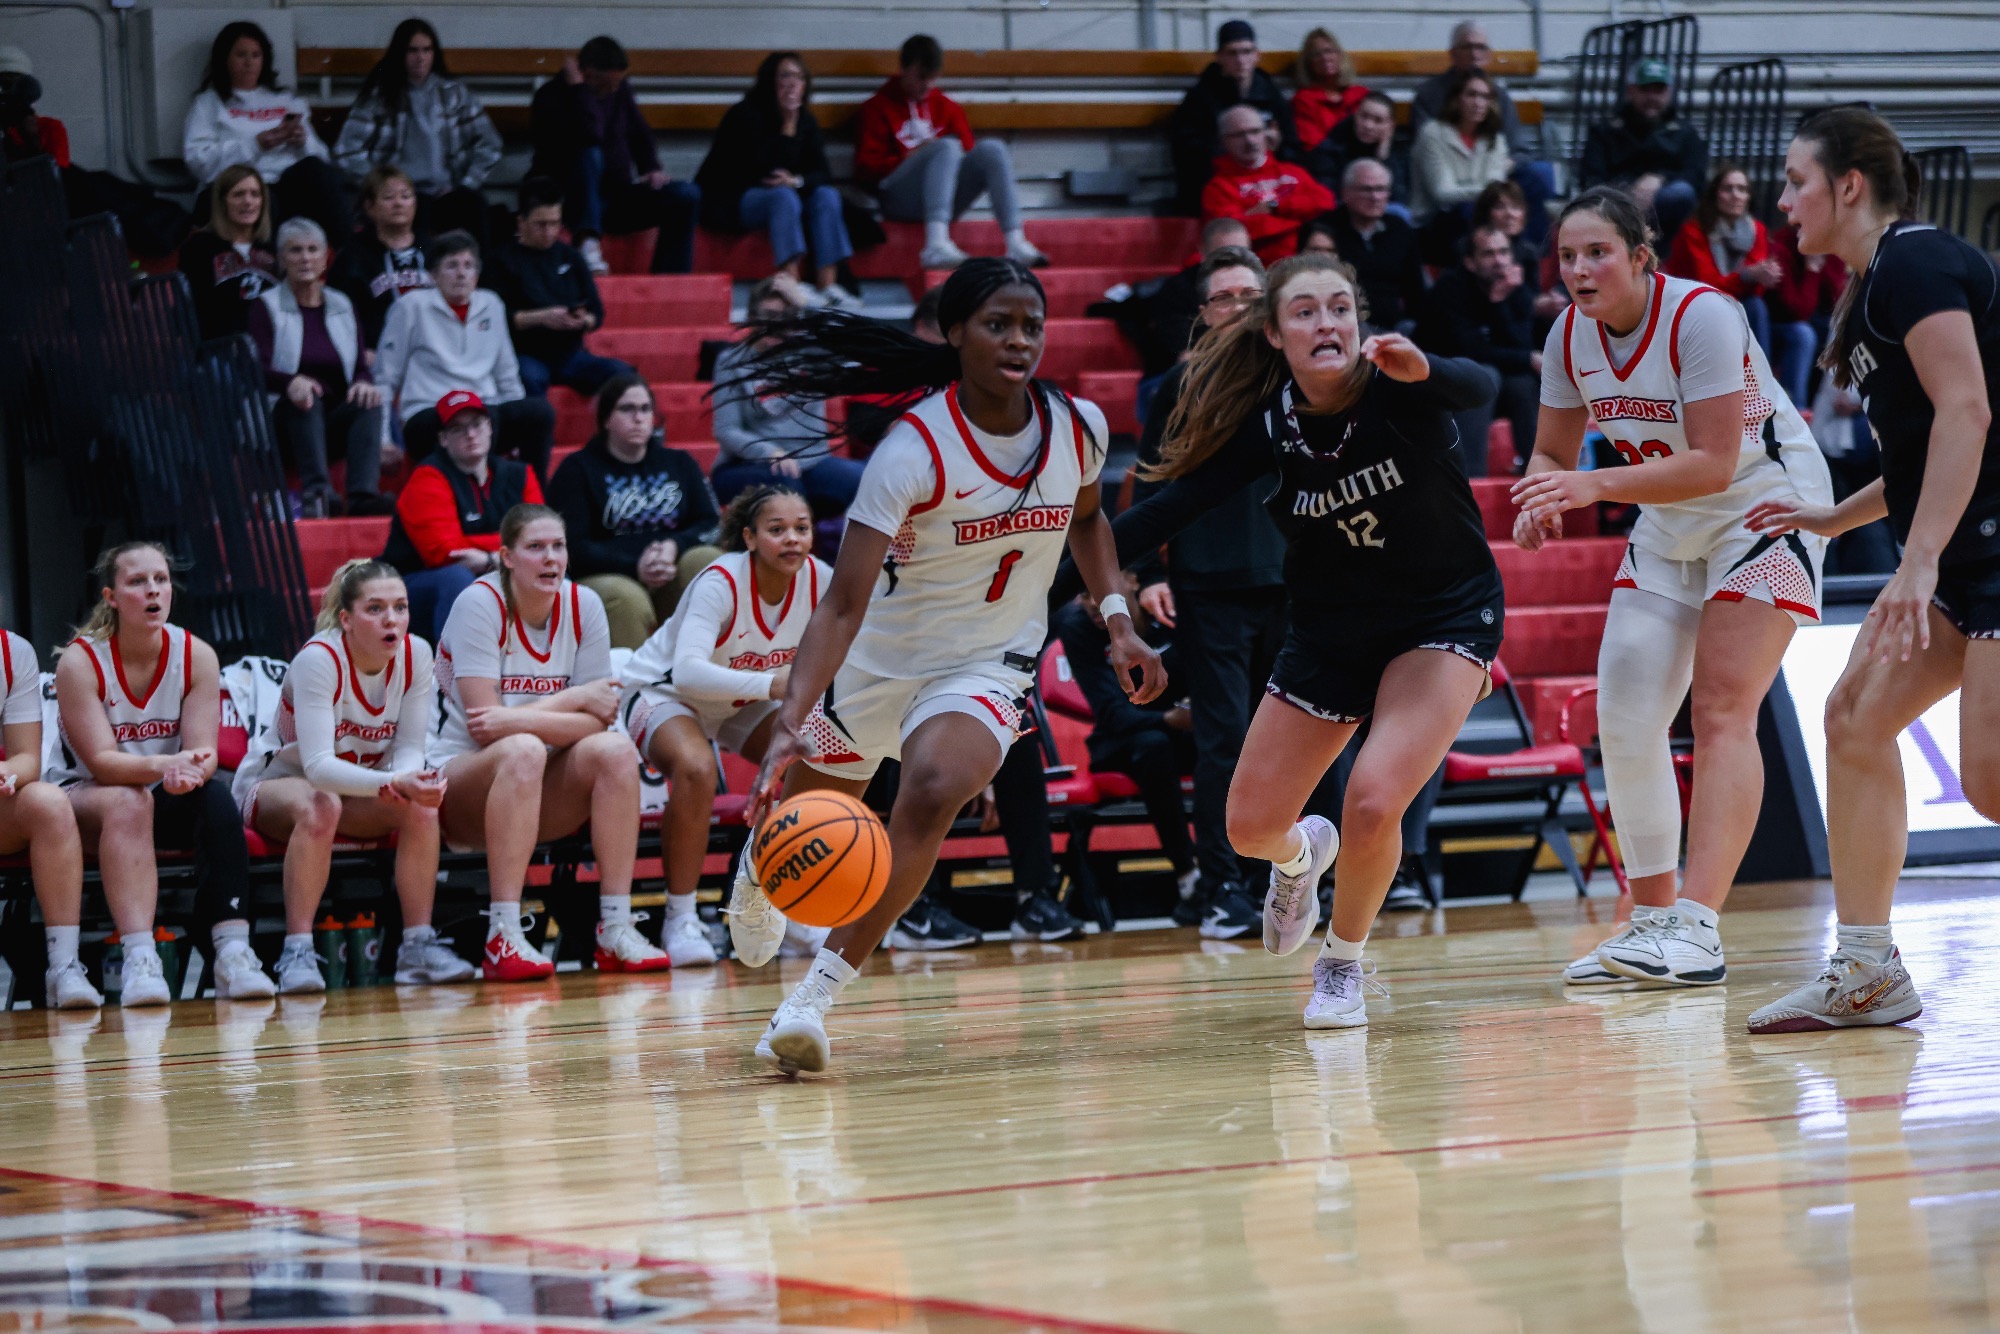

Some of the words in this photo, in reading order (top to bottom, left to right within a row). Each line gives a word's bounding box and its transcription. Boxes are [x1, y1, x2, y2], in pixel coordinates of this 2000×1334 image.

[1590, 397, 1676, 422] DRAGONS
[1293, 457, 1404, 517] DULUTH
[954, 505, 1072, 544] DRAGONS
[1337, 510, 1385, 548] 12
[985, 549, 1023, 603] 1
[501, 675, 569, 694] DRAGON
[764, 838, 834, 895] Wilson
